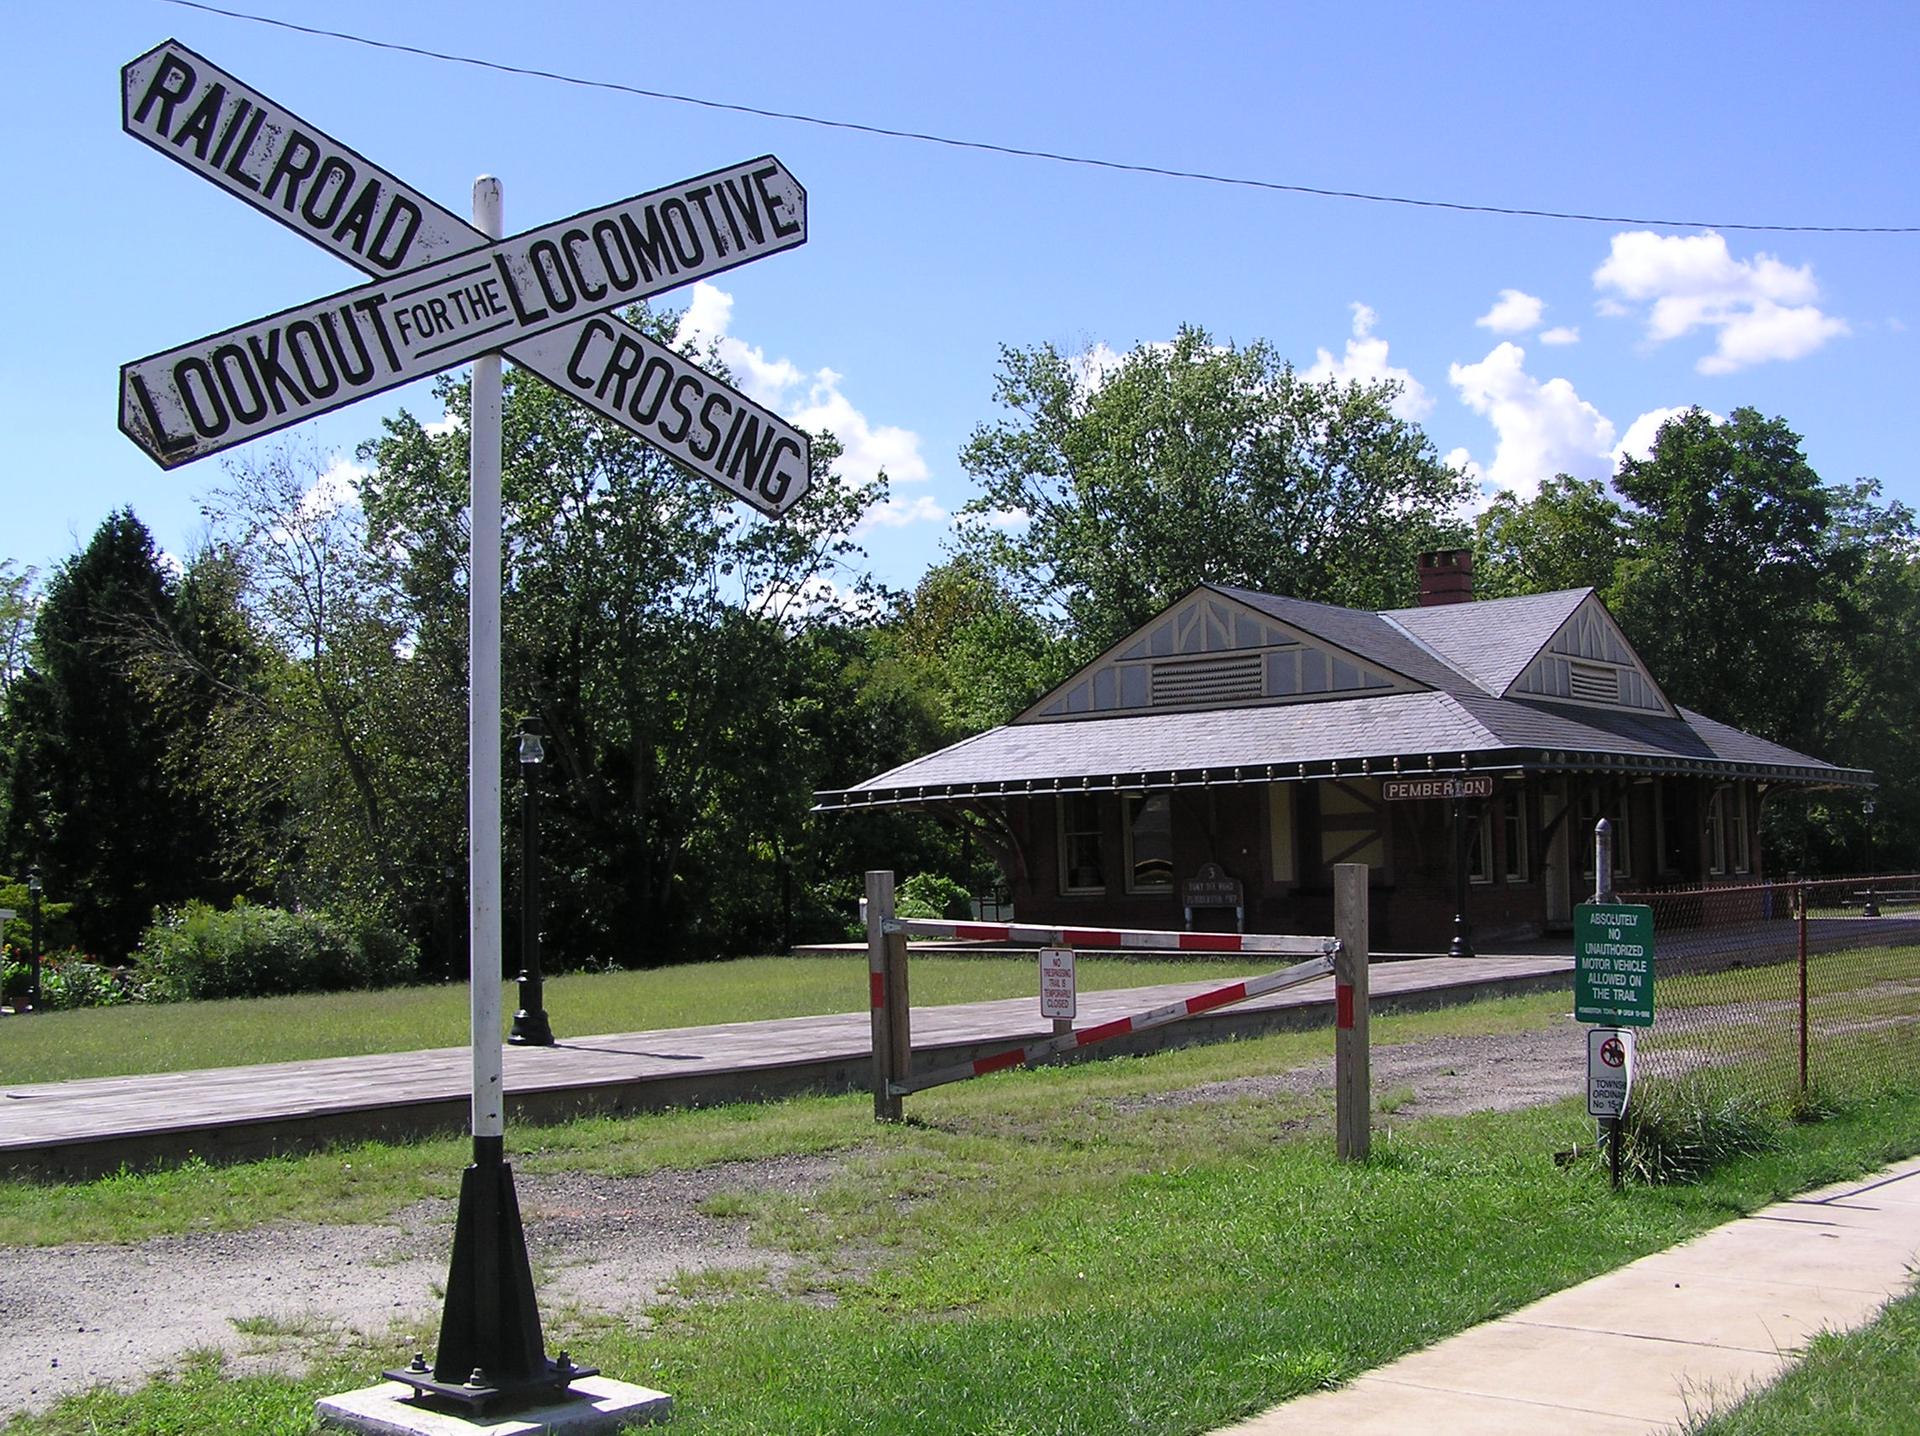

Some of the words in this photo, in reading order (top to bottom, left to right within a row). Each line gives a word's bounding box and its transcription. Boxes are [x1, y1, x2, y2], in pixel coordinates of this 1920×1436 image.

[134, 51, 422, 271] RAILROAD
[394, 298, 449, 347] FOR
[449, 279, 508, 328] THE
[494, 166, 801, 328] LOCOMOTIVE
[566, 319, 801, 504] CROSSING
[1590, 913, 1638, 926] ABSOLUTELY
[1608, 928, 1621, 940] NO
[1585, 943, 1644, 957] UNAUTHORIZED
[1053, 958, 1062, 967] NO
[1582, 958, 1611, 970] MOTOR
[1613, 959, 1647, 973] VEHICLE
[1588, 973, 1627, 986] ALLOWED
[1629, 975, 1642, 987] ON
[1592, 987, 1610, 1000] THE
[1613, 989, 1638, 1002] TRAIL
[1047, 999, 1069, 1008] CLOSED
